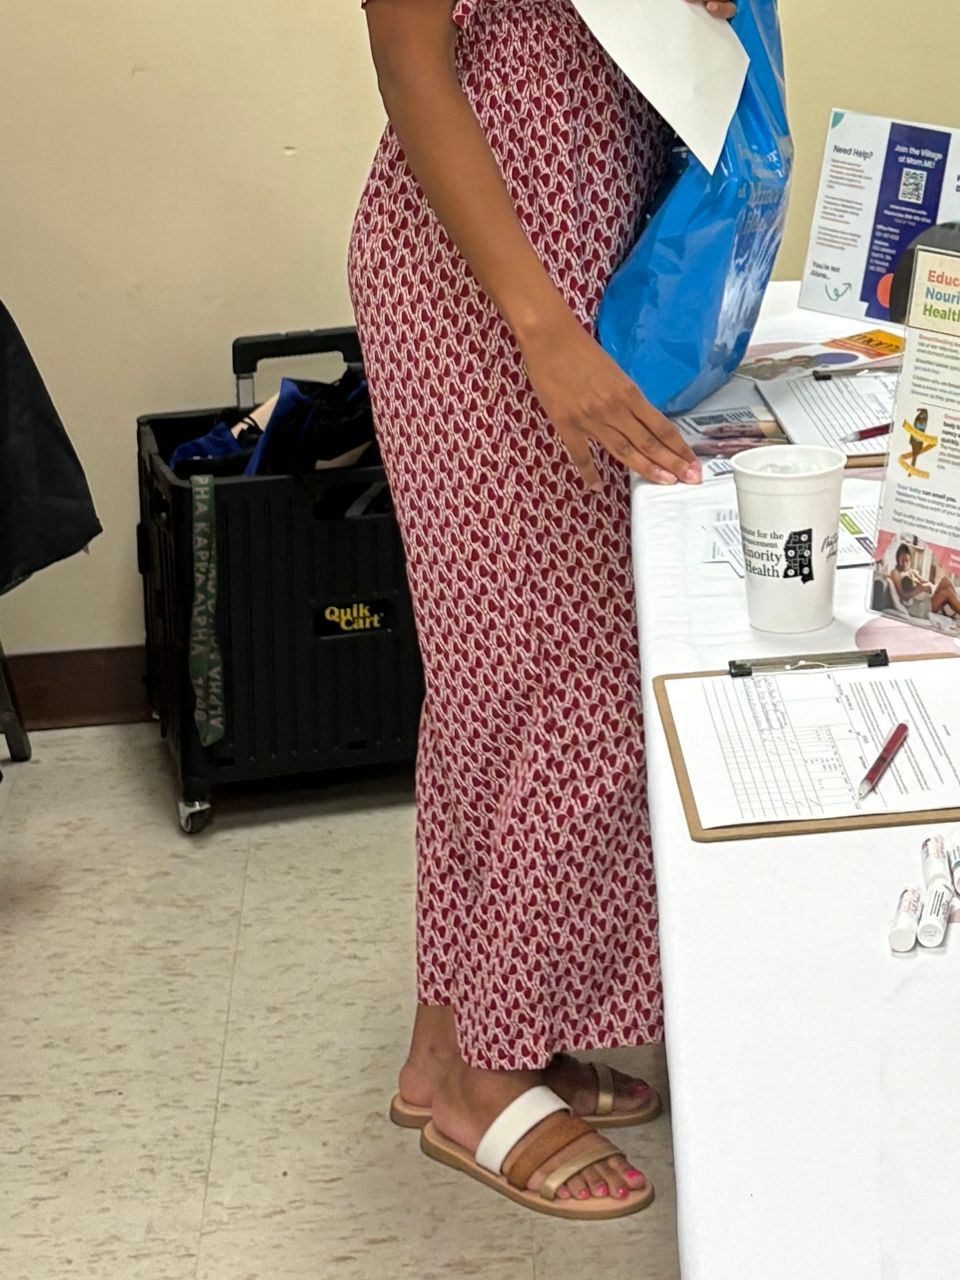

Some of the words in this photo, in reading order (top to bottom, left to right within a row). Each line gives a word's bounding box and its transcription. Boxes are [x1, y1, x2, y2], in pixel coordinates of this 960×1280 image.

[833, 144, 852, 155] Need
[853, 147, 874, 160] Help?
[894, 144, 908, 154] Join
[920, 148, 943, 161] Village
[757, 530, 768, 540] for
[770, 531, 784, 540] the
[324, 603, 371, 623] Quik
[340, 613, 381, 631] Cart
